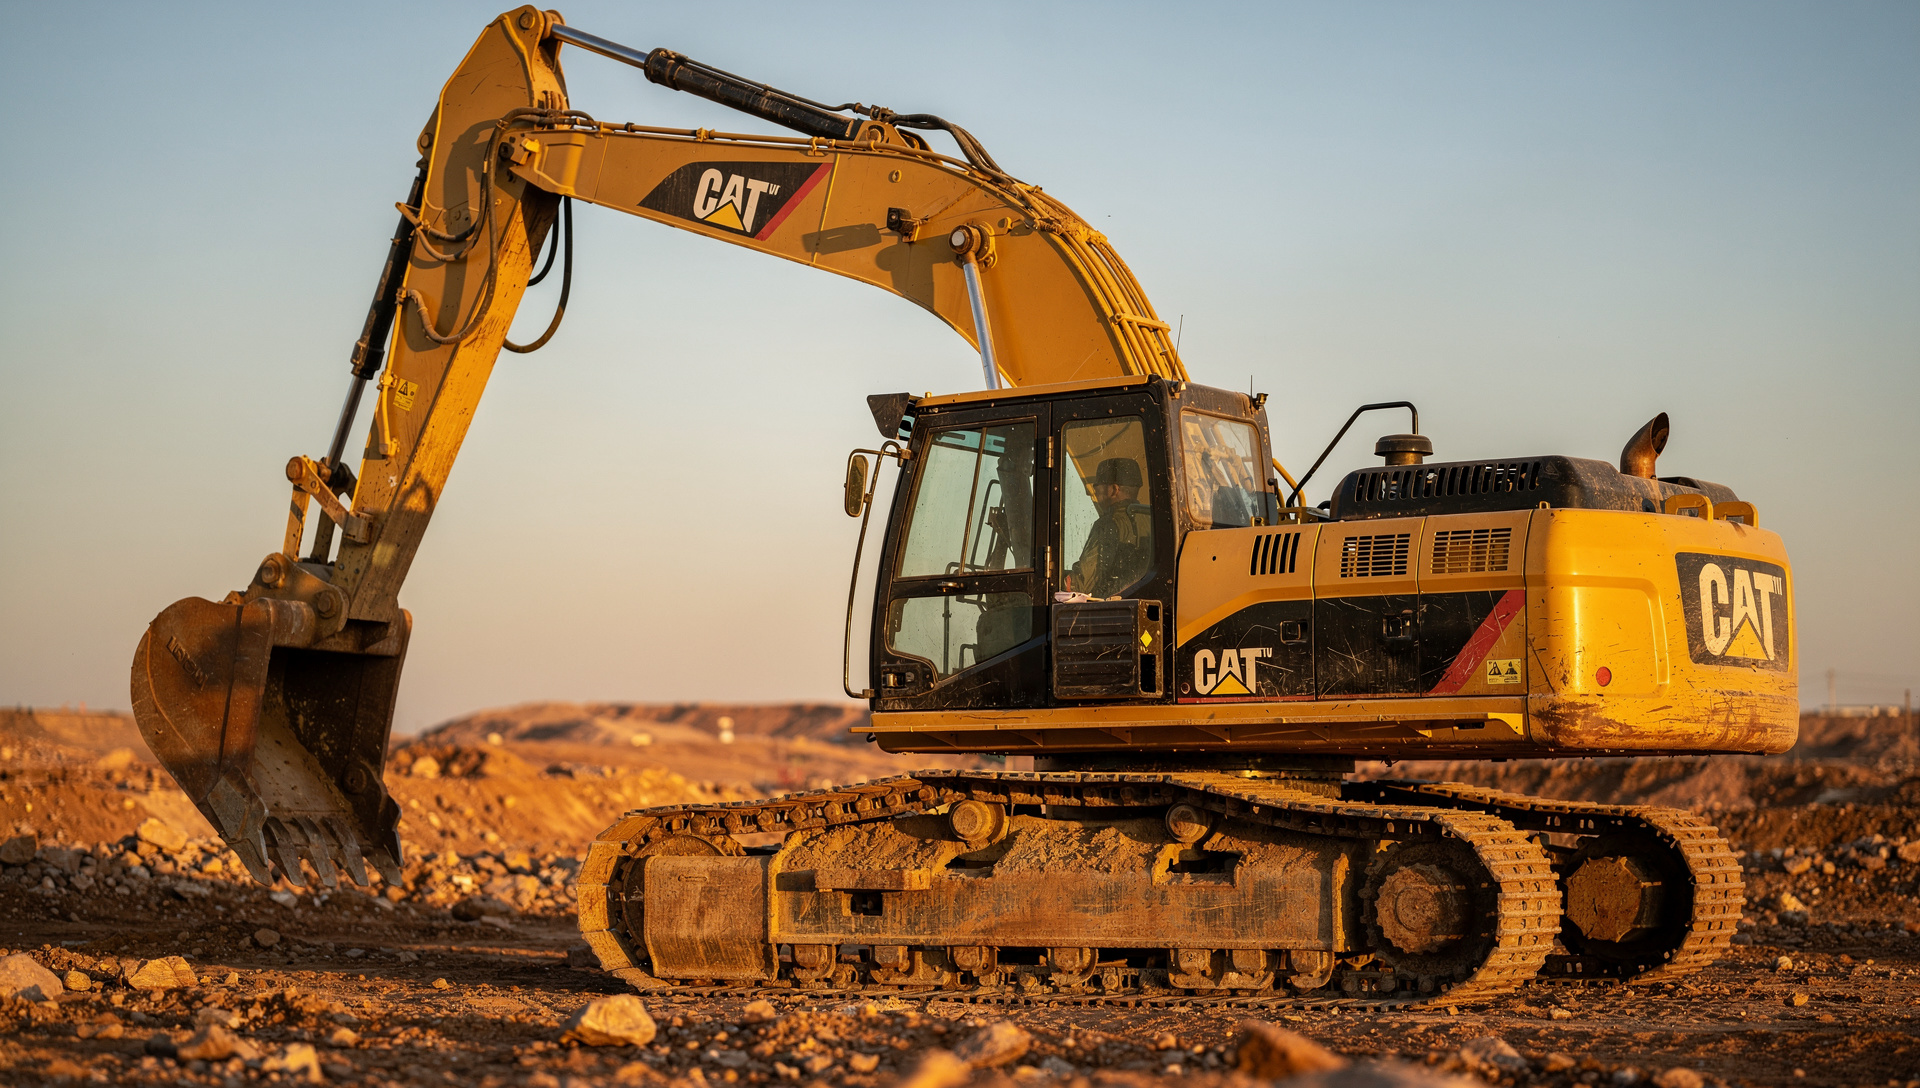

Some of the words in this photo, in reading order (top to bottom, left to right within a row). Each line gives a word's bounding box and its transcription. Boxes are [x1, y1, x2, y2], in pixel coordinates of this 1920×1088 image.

[693, 168, 770, 233] CAT
[1699, 563, 1774, 661] CAT
[1194, 648, 1262, 695] CAT
